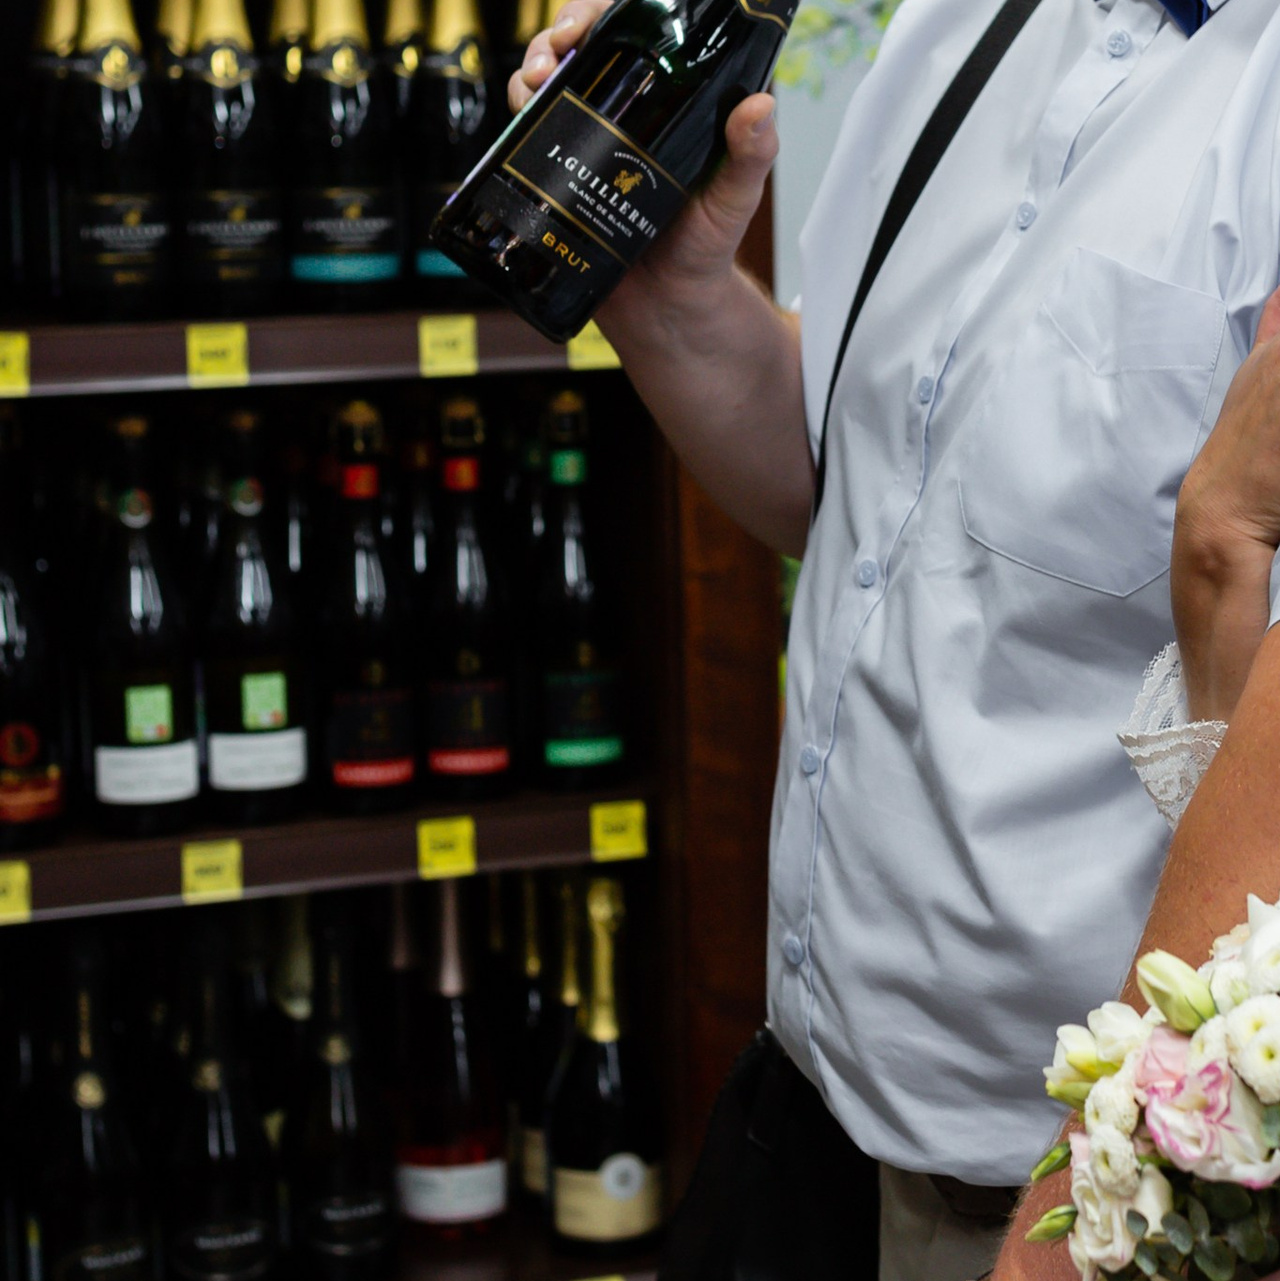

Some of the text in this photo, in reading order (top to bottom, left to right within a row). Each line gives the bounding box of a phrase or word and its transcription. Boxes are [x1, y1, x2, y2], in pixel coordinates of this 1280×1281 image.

[547, 144, 657, 239] J.GUILLERMIN
[568, 181, 596, 206] BLANC
[595, 203, 608, 216] DE
[541, 231, 591, 273] BRUT
